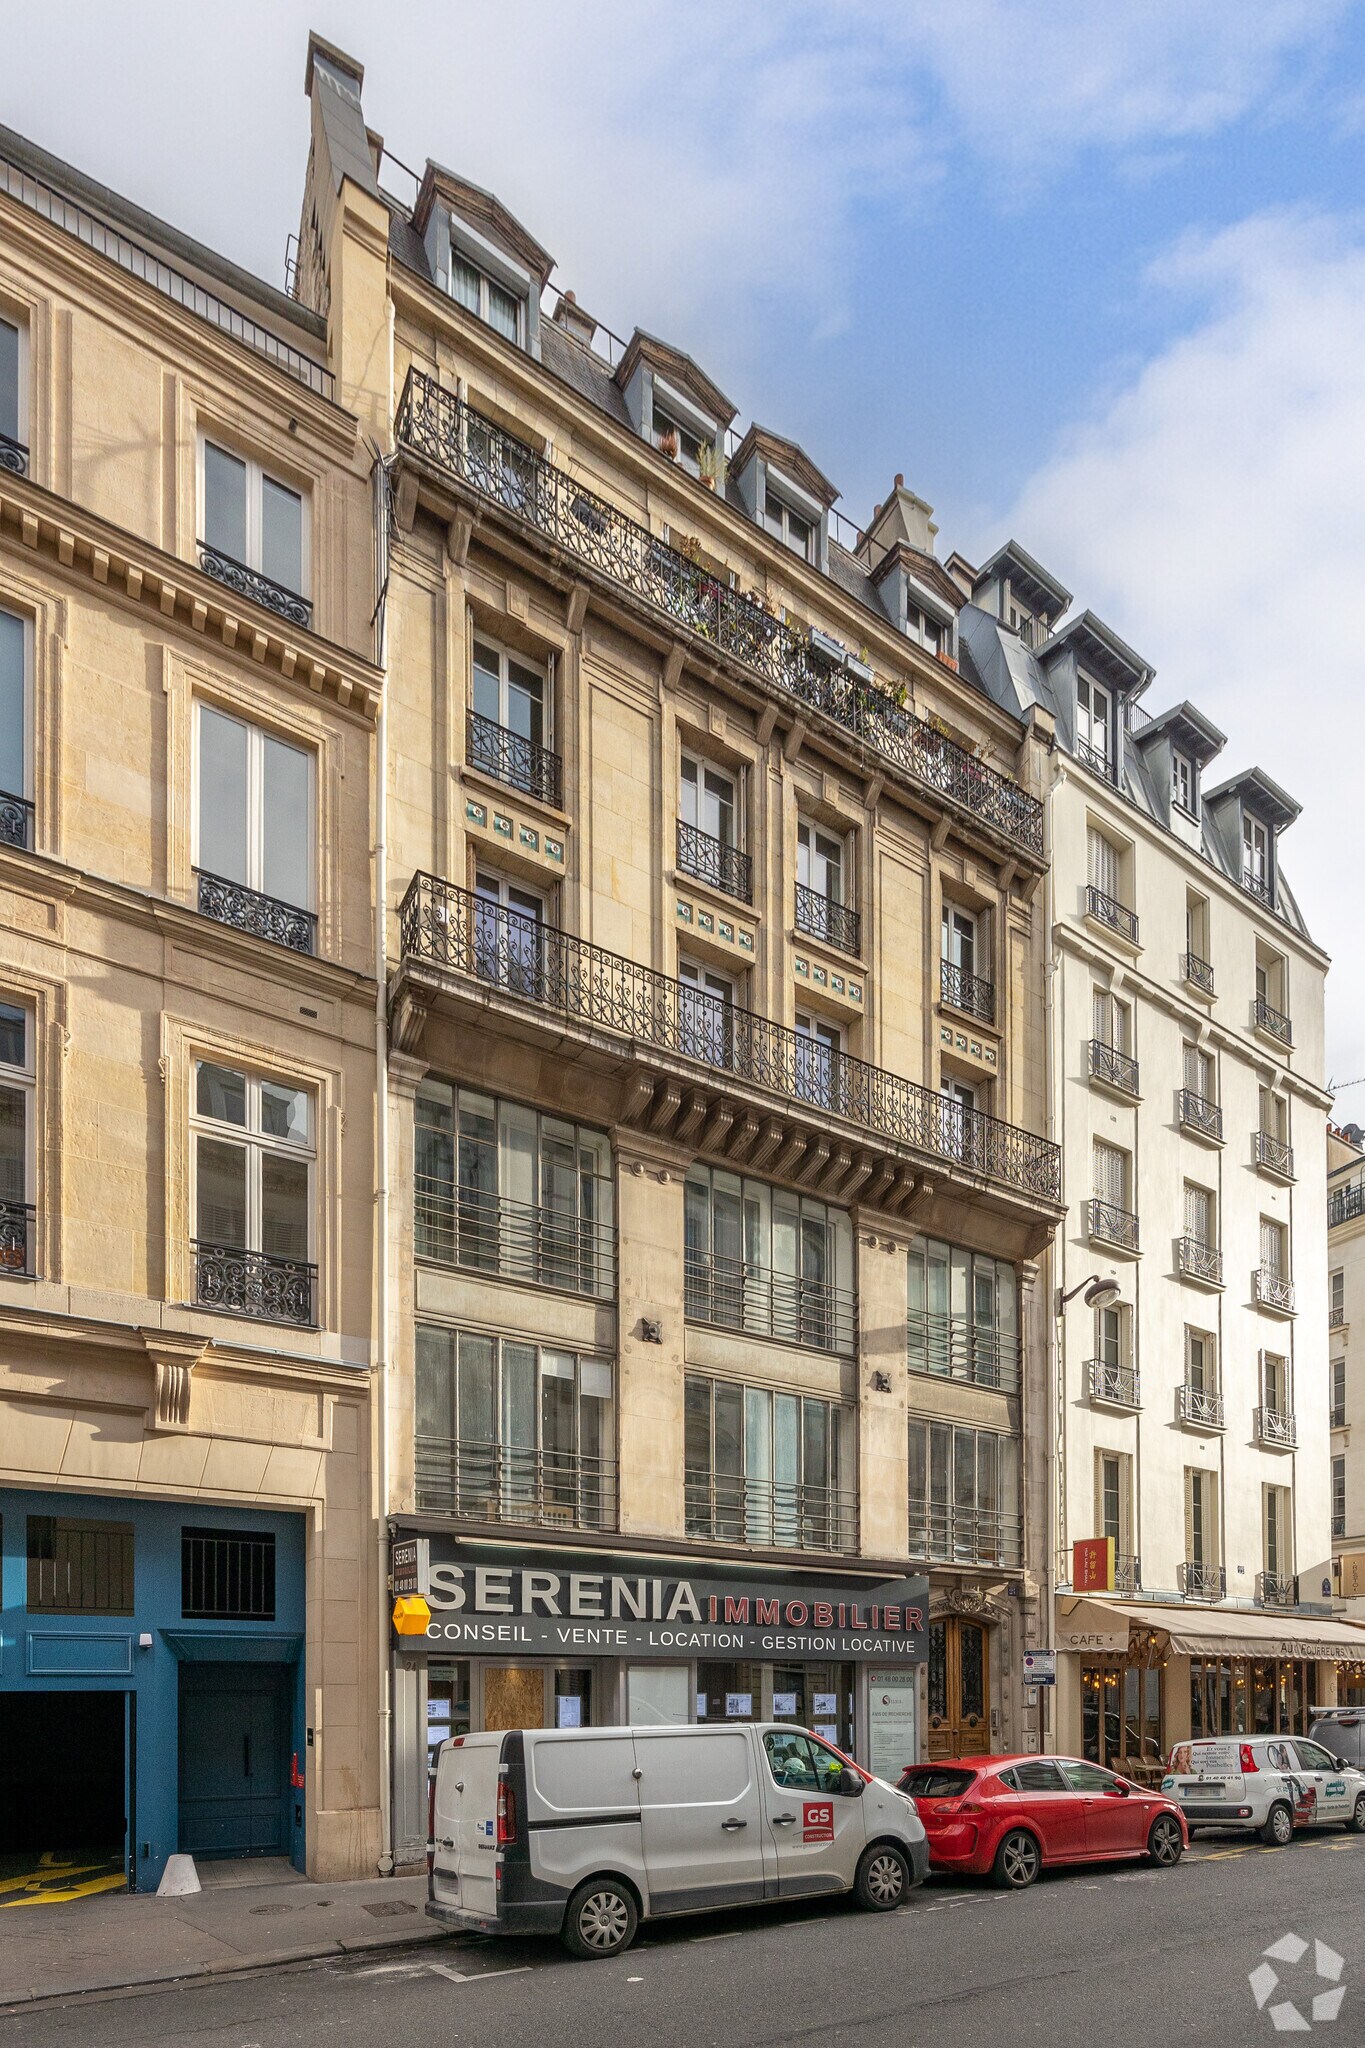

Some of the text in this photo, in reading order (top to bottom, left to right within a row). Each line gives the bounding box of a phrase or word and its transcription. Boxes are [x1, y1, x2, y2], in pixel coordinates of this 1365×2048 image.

[394, 1547, 416, 1565] SERENIA
[423, 1563, 702, 1621] SERENIA
[709, 1595, 924, 1632] IMMOBILIER
[425, 1623, 532, 1642] CONSEIL
[556, 1627, 628, 1645] VENTE
[649, 1631, 743, 1648] LOCATION
[762, 1636, 836, 1651] GESTION
[842, 1637, 915, 1653] LOCATIVE
[1070, 1635, 1104, 1645] CAFE
[808, 1809, 829, 1823] GS
